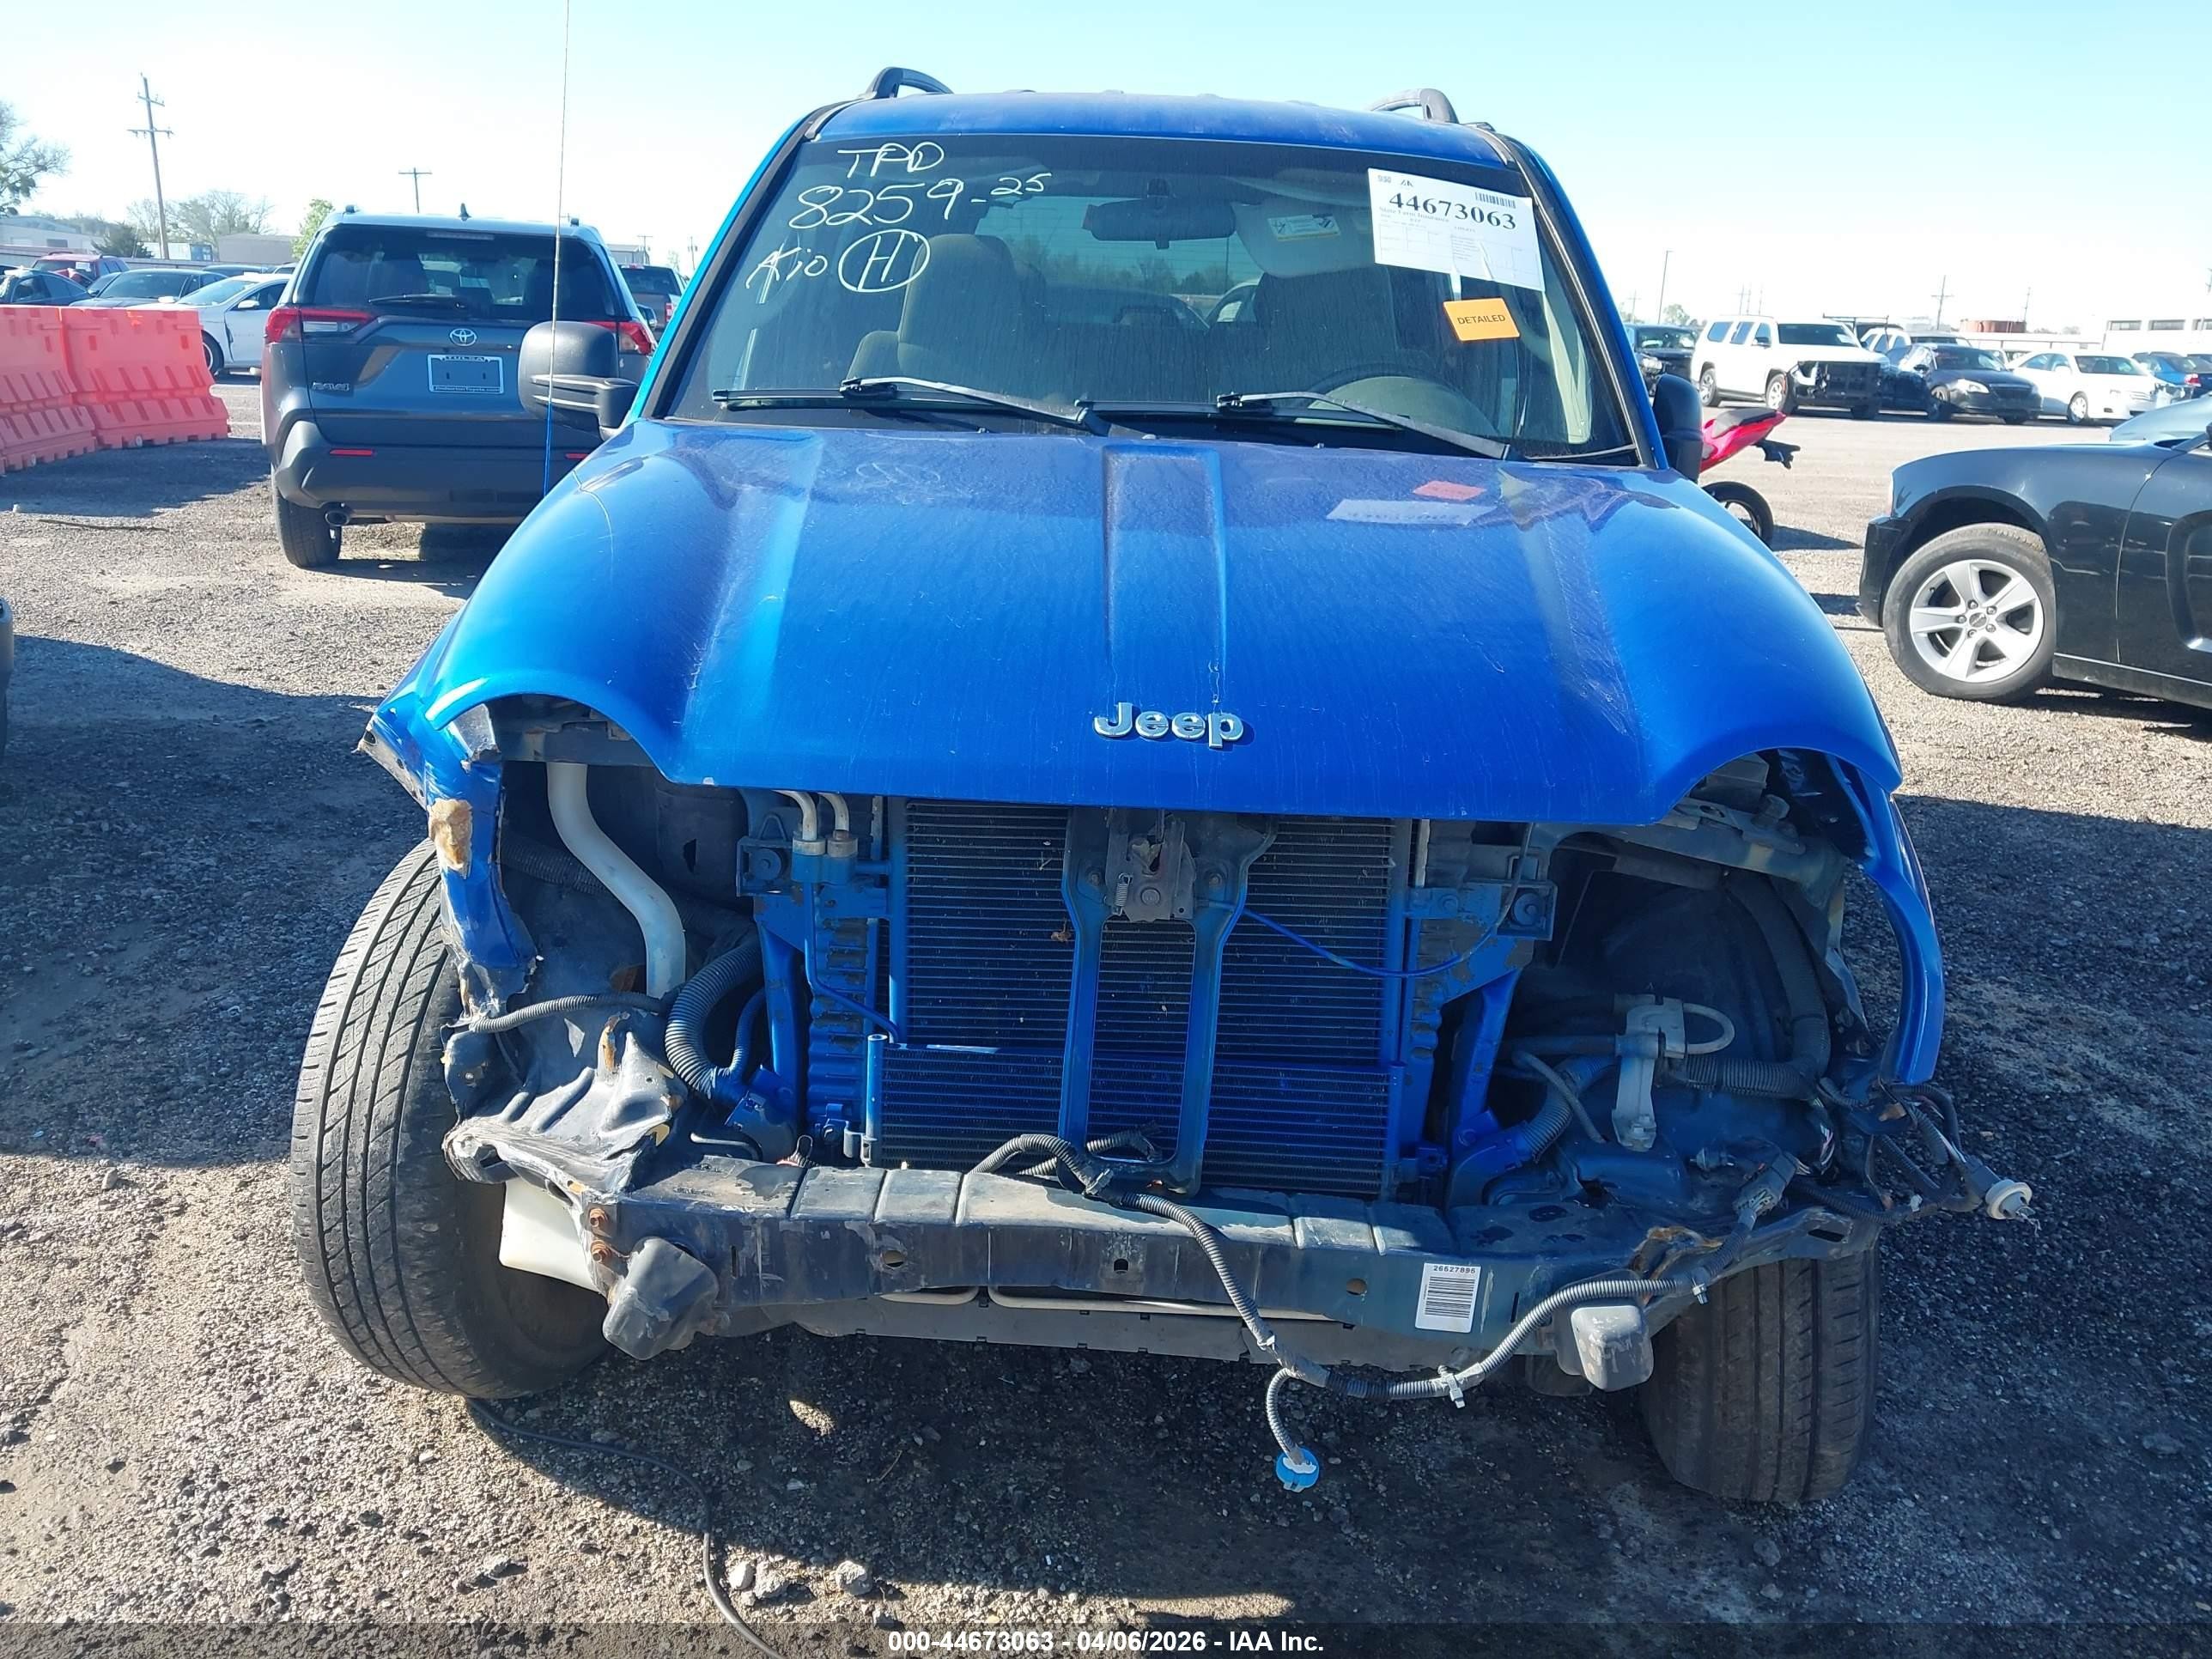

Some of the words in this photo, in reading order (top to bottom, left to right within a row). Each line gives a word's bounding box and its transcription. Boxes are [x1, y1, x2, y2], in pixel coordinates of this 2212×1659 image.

[837, 141, 945, 178] TPD
[1389, 191, 1516, 231] 44673063
[1456, 314, 1506, 325] DETAILED
[1094, 702, 1244, 749] Jeep
